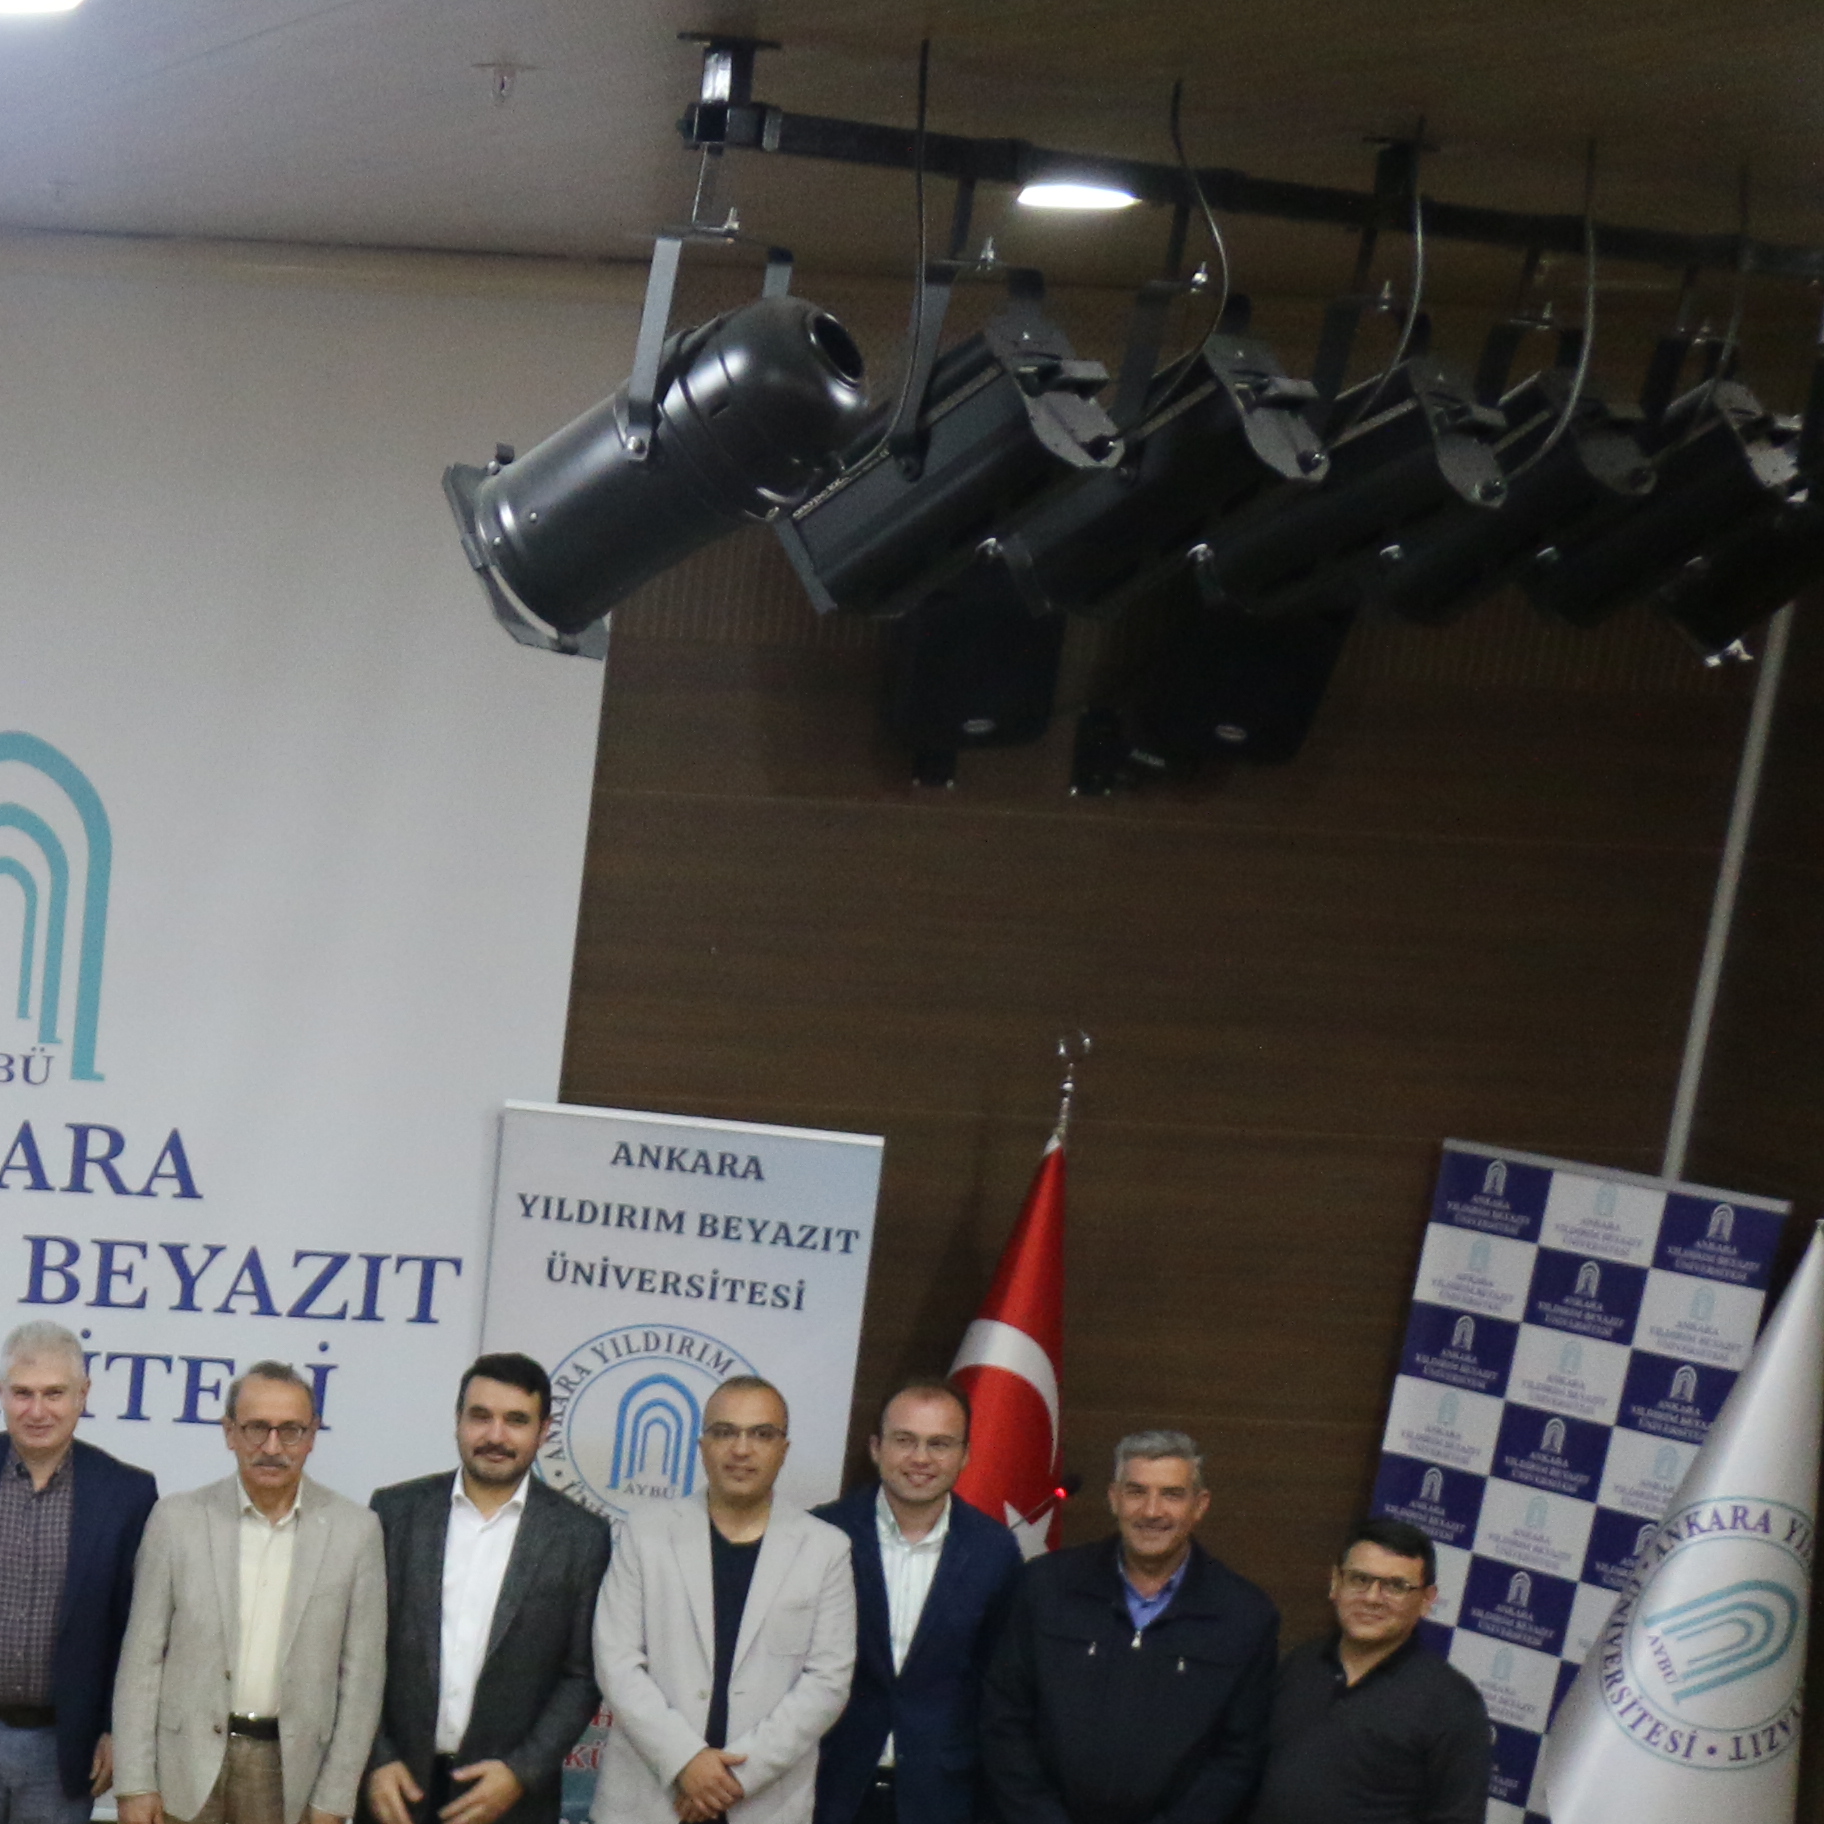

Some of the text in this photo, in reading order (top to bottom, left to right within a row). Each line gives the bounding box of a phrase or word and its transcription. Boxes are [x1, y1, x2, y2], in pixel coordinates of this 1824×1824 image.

[610, 1140, 766, 1181] ANKARA
[517, 1192, 859, 1254] YILDIRIM BEYAZIT
[17, 1233, 462, 1325] BEYAZIT
[545, 1250, 806, 1311] ÜNİVERSİTESİ
[591, 1330, 736, 1376] YILDIRIM
